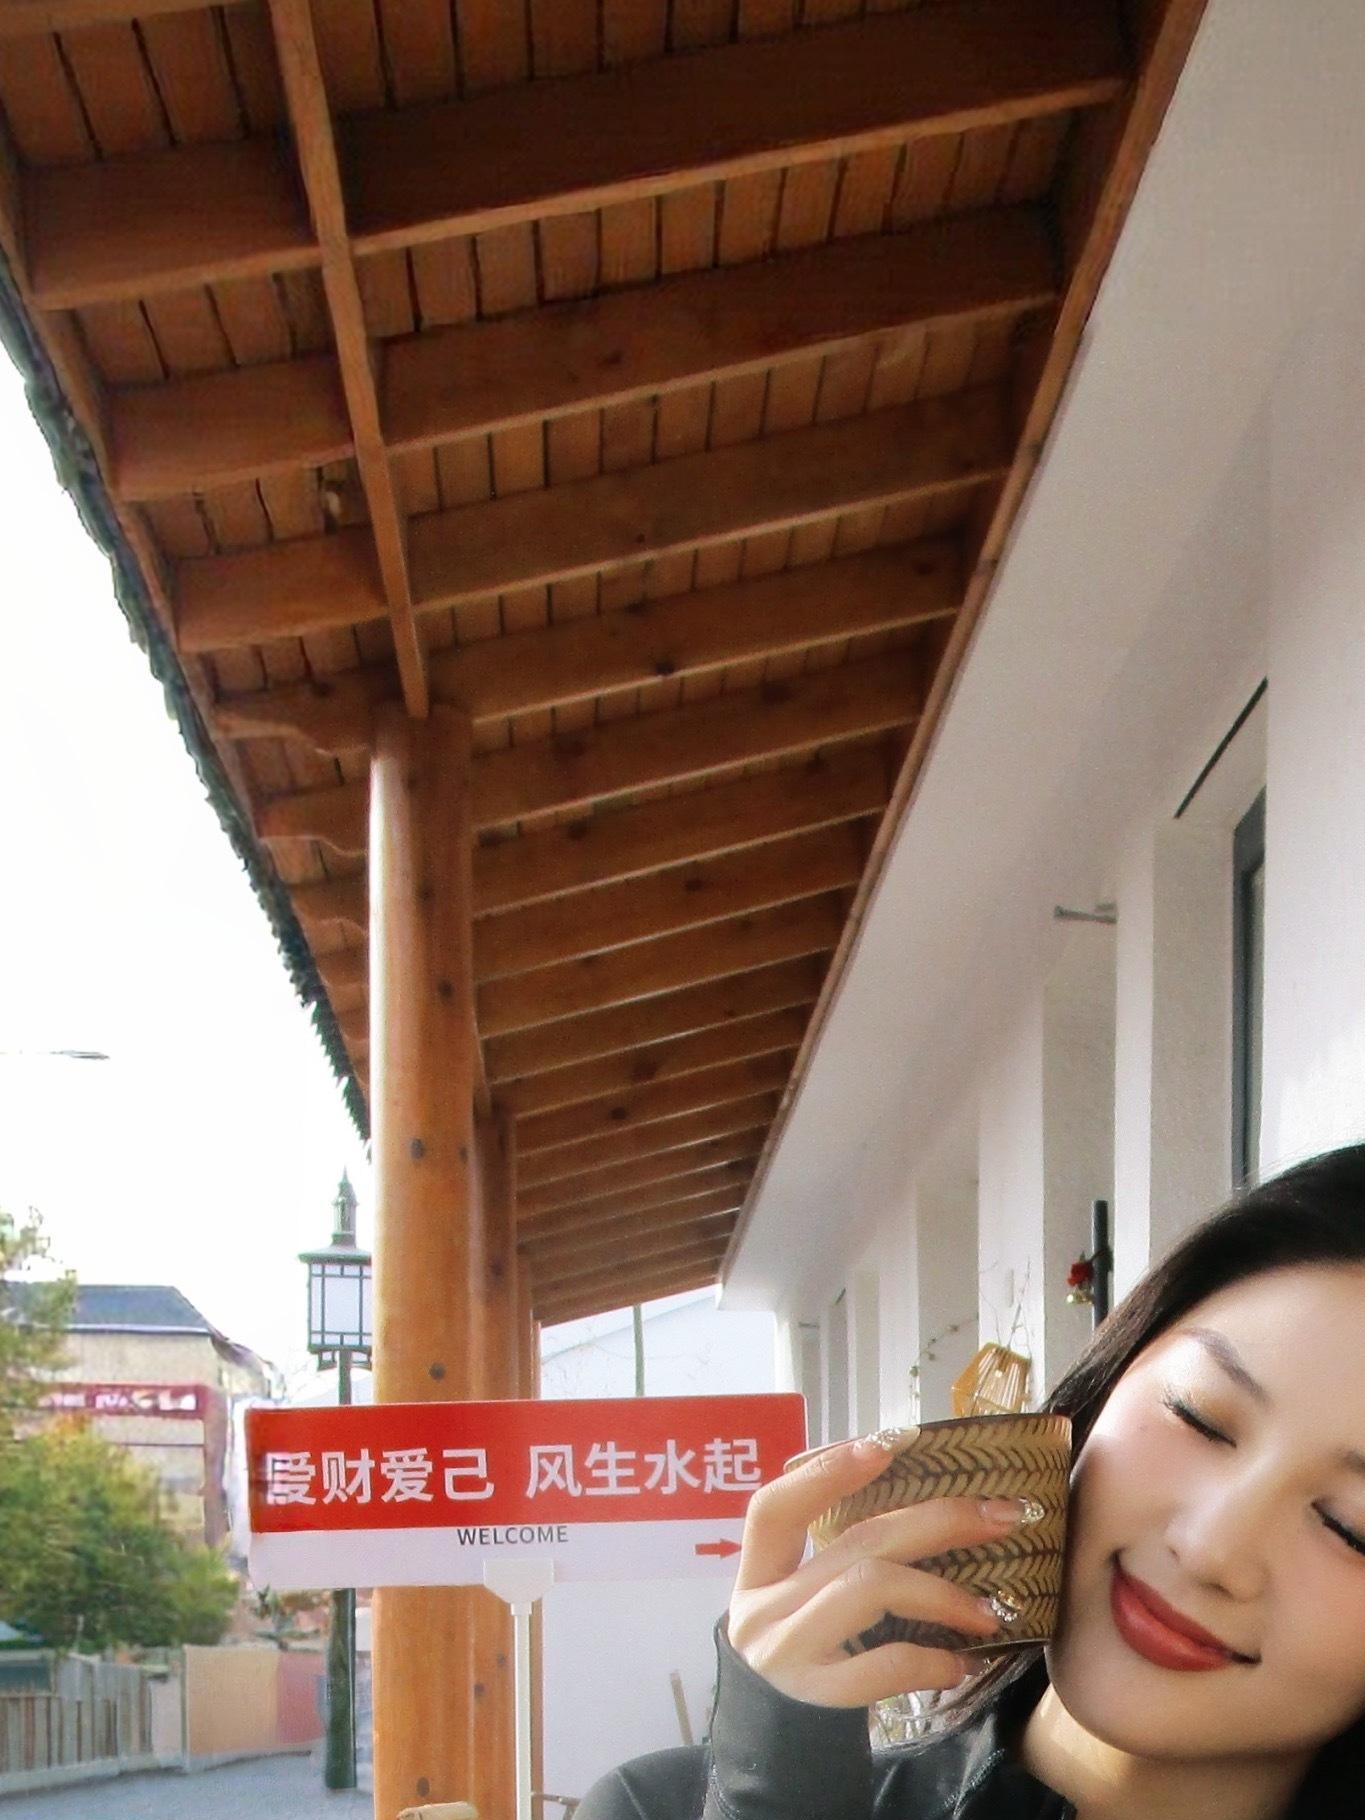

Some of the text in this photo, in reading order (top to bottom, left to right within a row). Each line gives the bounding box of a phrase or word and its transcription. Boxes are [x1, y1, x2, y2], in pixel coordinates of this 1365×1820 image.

[526, 1437, 762, 1500] 风生水起
[457, 1524, 570, 1547] WELCOME
